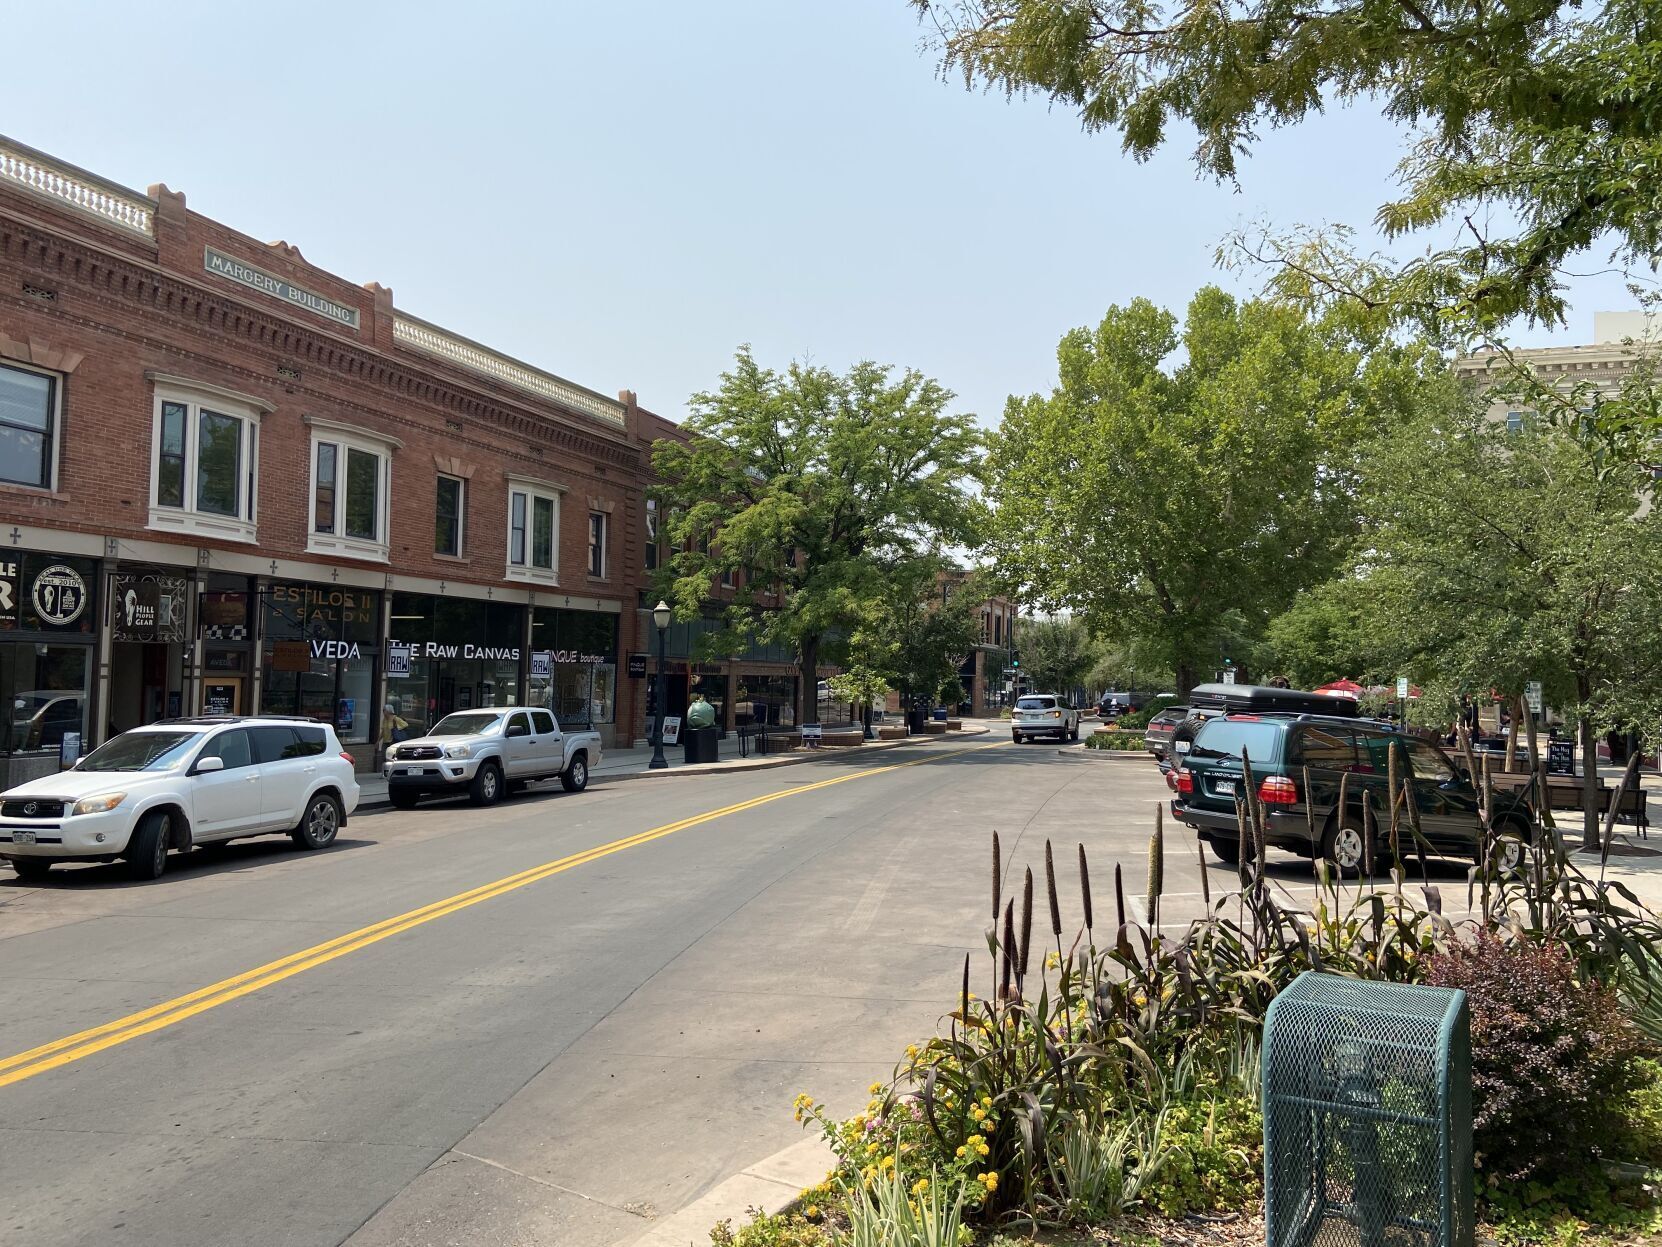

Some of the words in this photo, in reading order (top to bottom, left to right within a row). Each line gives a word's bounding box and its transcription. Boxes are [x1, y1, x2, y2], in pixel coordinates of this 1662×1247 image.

[211, 255, 283, 293] MARGERY
[288, 286, 350, 321] BUILDING
[273, 586, 356, 608] ESTILOS
[136, 605, 154, 614] HILL
[296, 607, 370, 622] SALON
[464, 644, 520, 660] CANVAS
[390, 655, 409, 671] RAW
[532, 660, 549, 674] RAW
